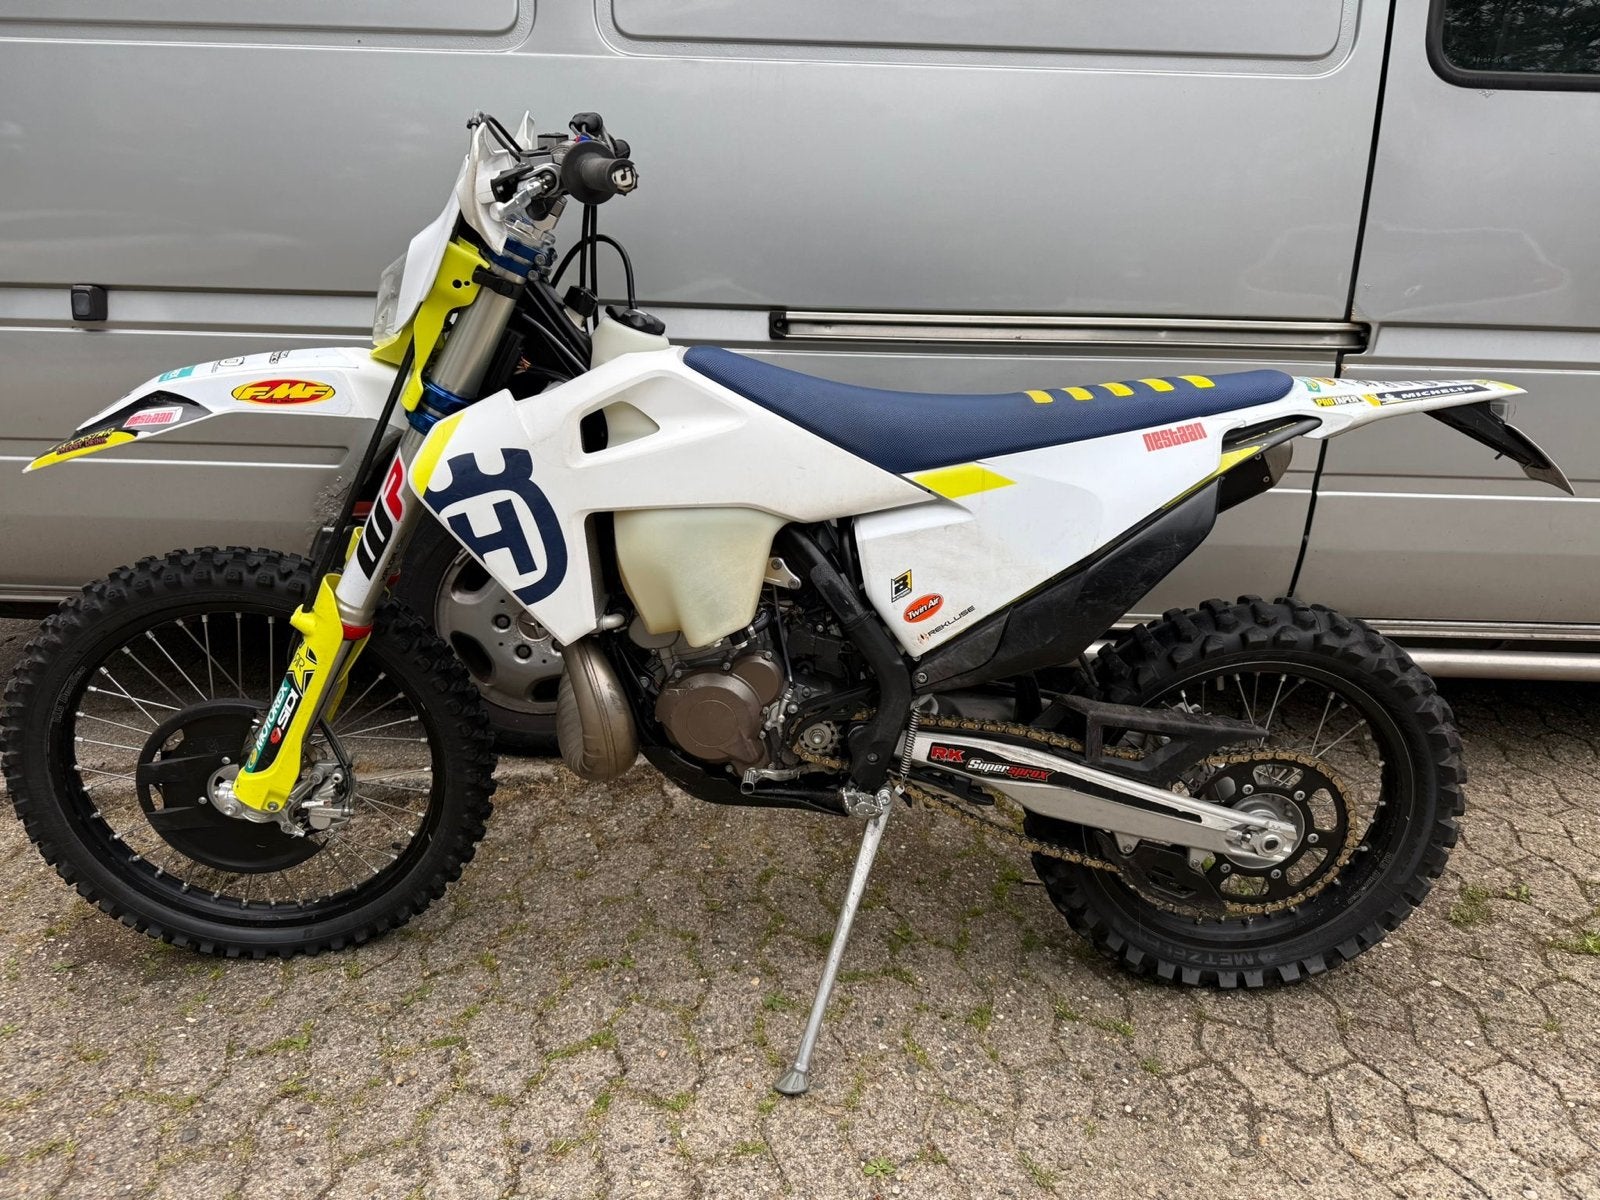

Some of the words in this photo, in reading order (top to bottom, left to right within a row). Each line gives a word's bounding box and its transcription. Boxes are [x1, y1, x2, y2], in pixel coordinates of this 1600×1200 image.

[239, 383, 330, 400] FMF
[1401, 385, 1475, 398] MICHELIN
[907, 605, 927, 621] Twin
[928, 596, 941, 609] Air
[927, 605, 976, 637] REKLUSE
[256, 682, 289, 751] MOTOREX
[277, 687, 300, 731] SIDI
[931, 745, 966, 763] RK
